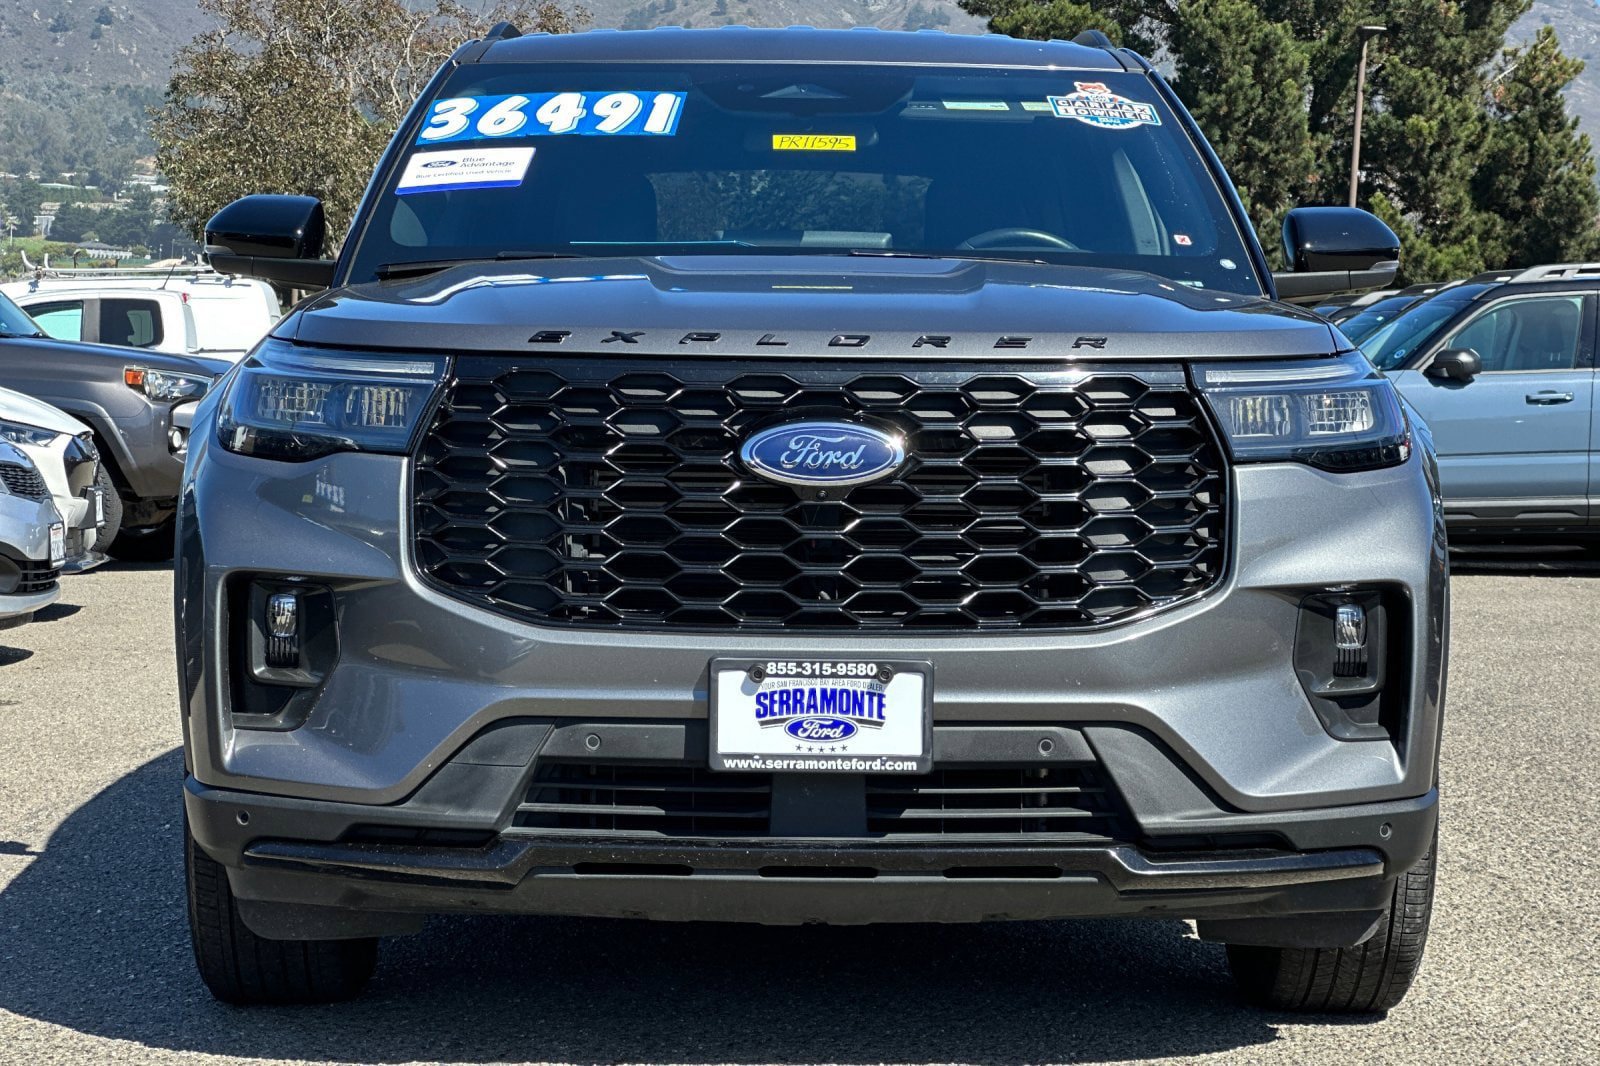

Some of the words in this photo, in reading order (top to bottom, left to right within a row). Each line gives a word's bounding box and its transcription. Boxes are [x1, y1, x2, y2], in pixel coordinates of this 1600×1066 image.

[1057, 99, 1148, 113] CARFAX
[420, 92, 682, 140] 36491
[1075, 108, 1154, 121] OWNER
[460, 161, 515, 169] Advantage
[433, 170, 464, 178] Certified
[527, 330, 1109, 349] EXPLORER
[780, 434, 867, 472] Ford
[765, 661, 878, 676] 855-315-9580
[776, 680, 788, 688] SAN
[788, 678, 818, 687] FRANCISCO
[819, 678, 830, 686] BAY
[846, 679, 861, 688] FORD
[862, 681, 883, 692] DEALER
[755, 687, 887, 720] SERRAMONTE
[798, 719, 844, 739] Ford
[723, 757, 917, 771] www.serramonteford.com
